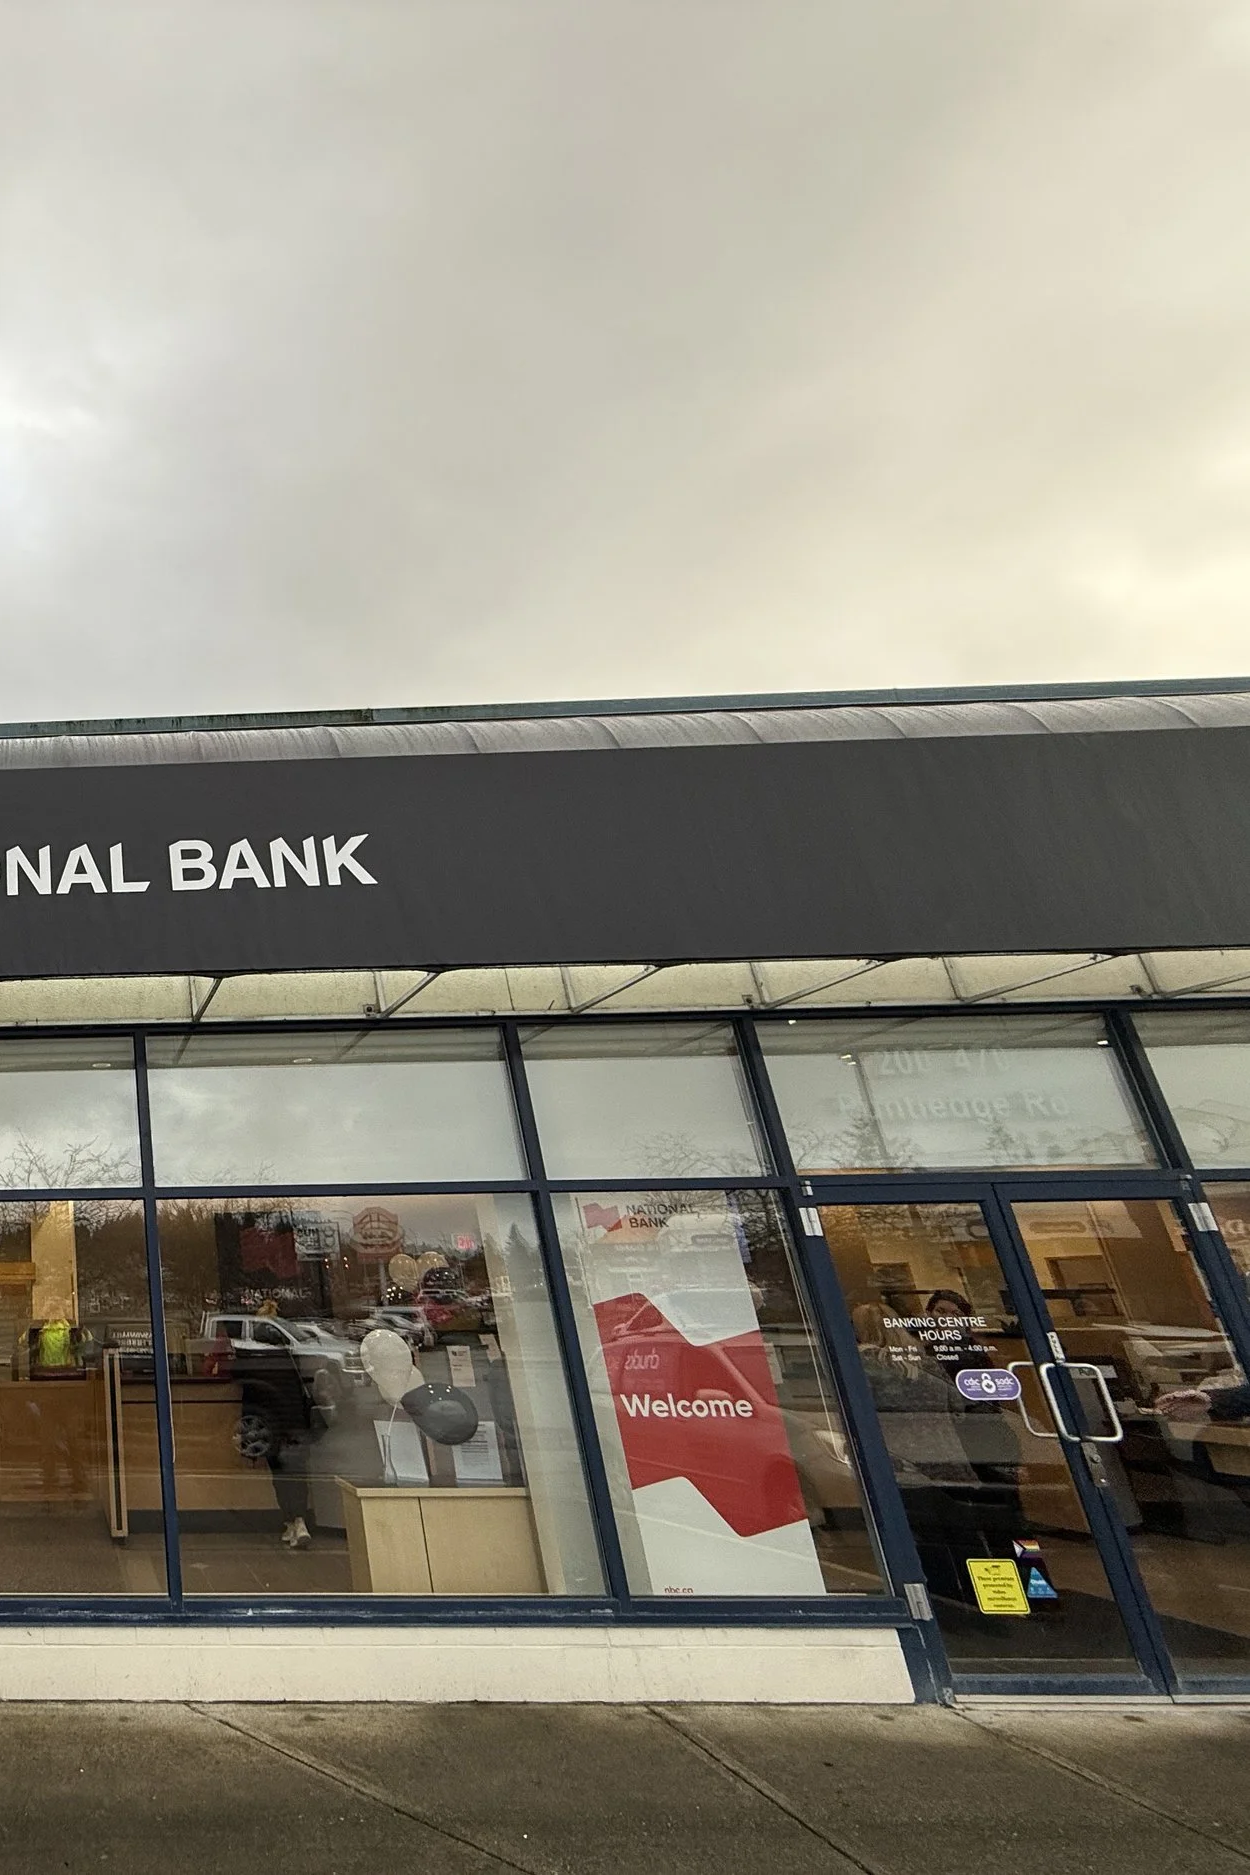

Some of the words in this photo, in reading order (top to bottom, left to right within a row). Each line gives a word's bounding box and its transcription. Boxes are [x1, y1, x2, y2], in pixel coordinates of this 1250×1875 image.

[169, 833, 378, 891] BANK
[626, 1203, 699, 1215] NATIONAL
[629, 1217, 669, 1228] BANK
[883, 1317, 936, 1328] BANKING
[937, 1316, 987, 1328] CENTRE
[918, 1330, 962, 1341] HOURS
[620, 1393, 754, 1418] Welcome
